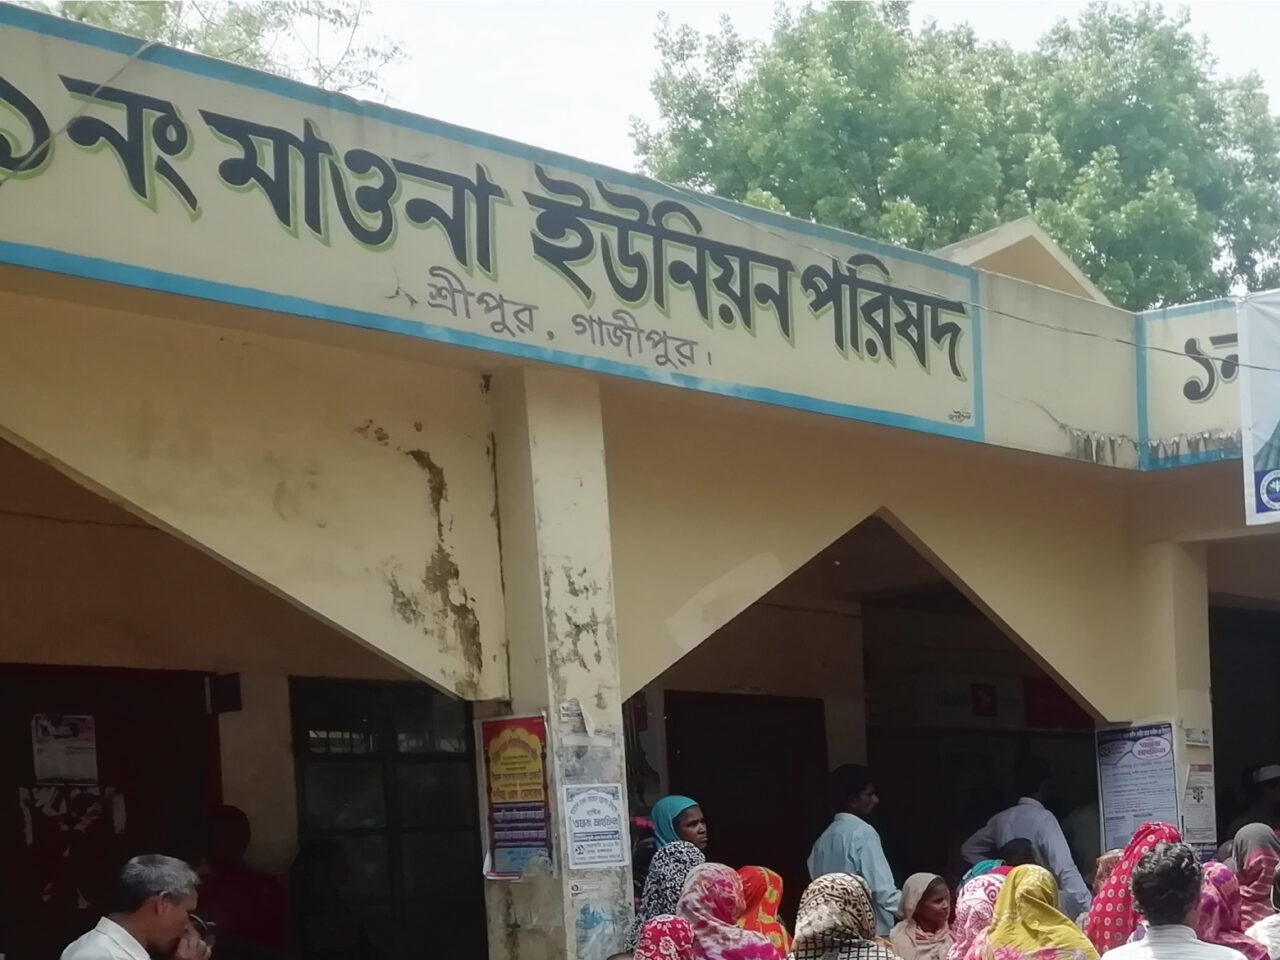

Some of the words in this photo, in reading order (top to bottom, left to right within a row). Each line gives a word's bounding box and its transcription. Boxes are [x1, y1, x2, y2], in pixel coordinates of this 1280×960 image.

[199, 109, 508, 276] মাওনা
[523, 163, 796, 342] ইউনিয়ন
[802, 253, 967, 379] পরিষদ
